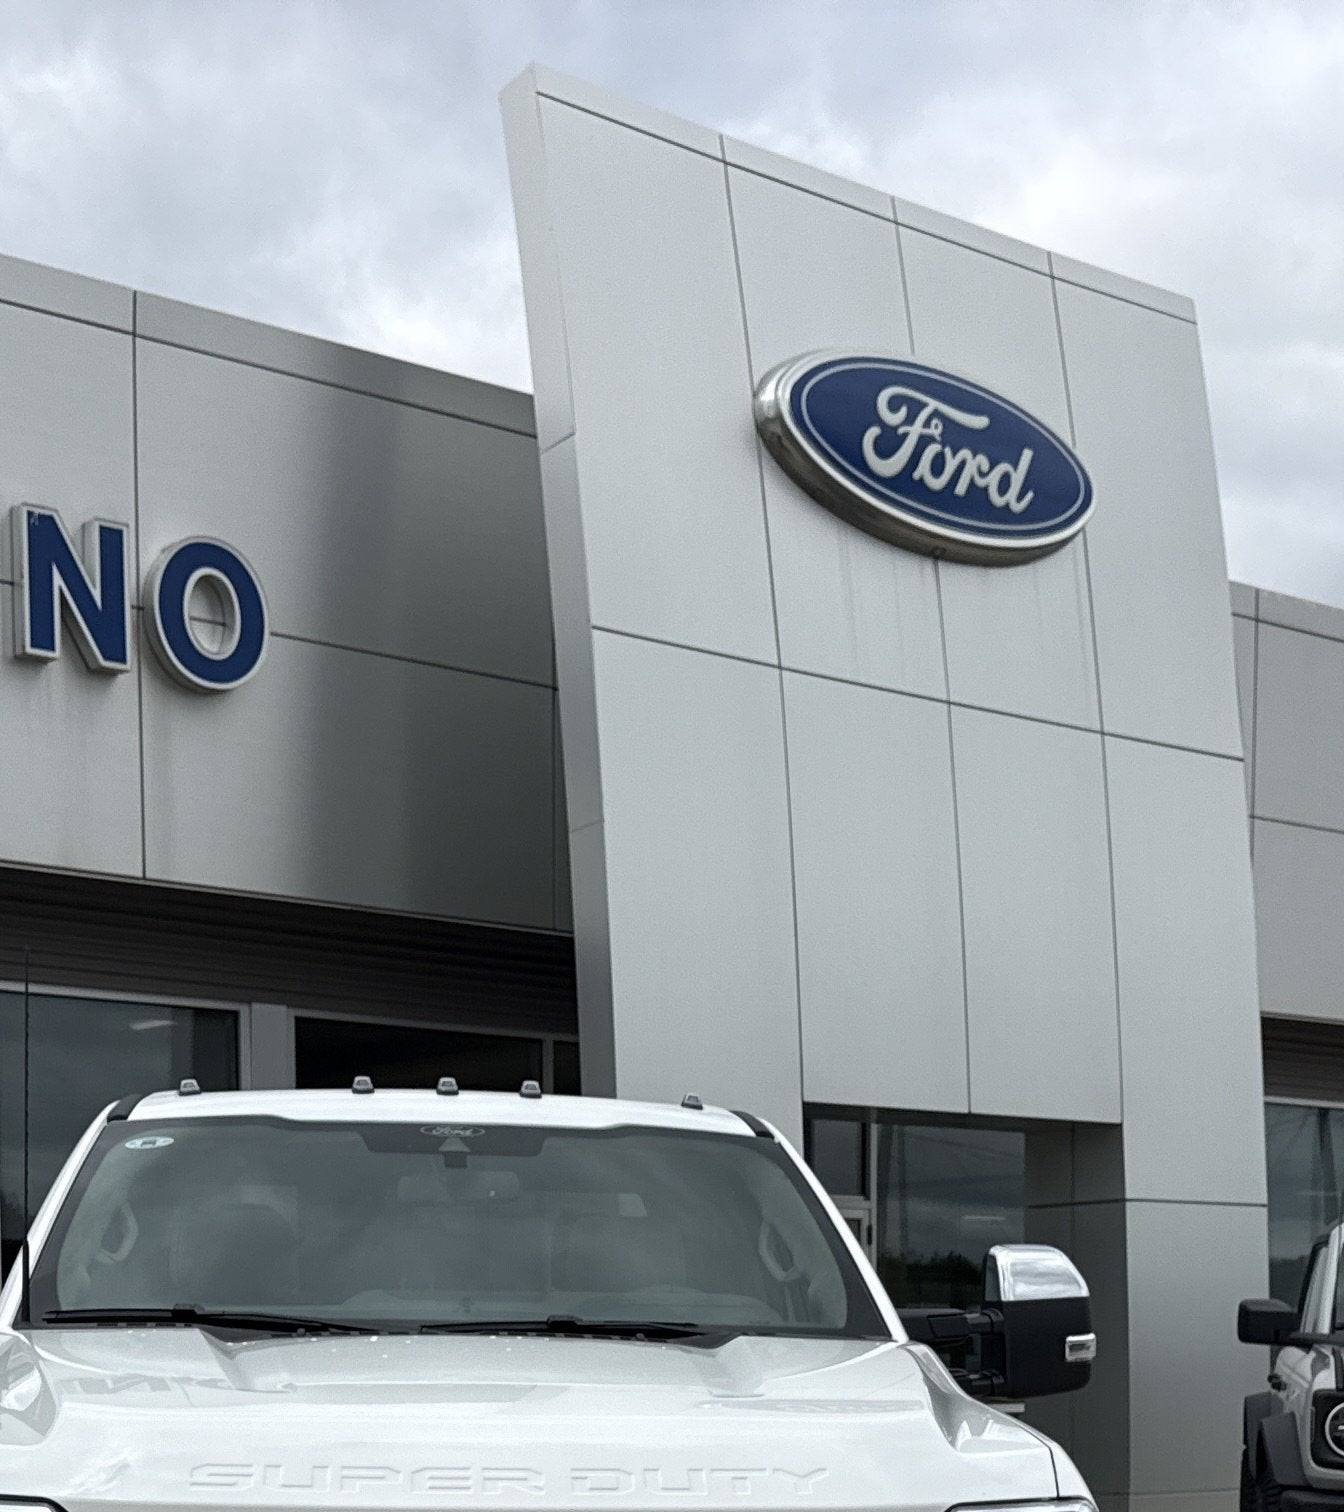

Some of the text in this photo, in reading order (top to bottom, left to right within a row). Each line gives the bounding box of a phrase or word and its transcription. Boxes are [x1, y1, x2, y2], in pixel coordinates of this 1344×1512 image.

[862, 385, 1035, 515] Ford
[188, 1462, 830, 1497] SUPER DUTY
